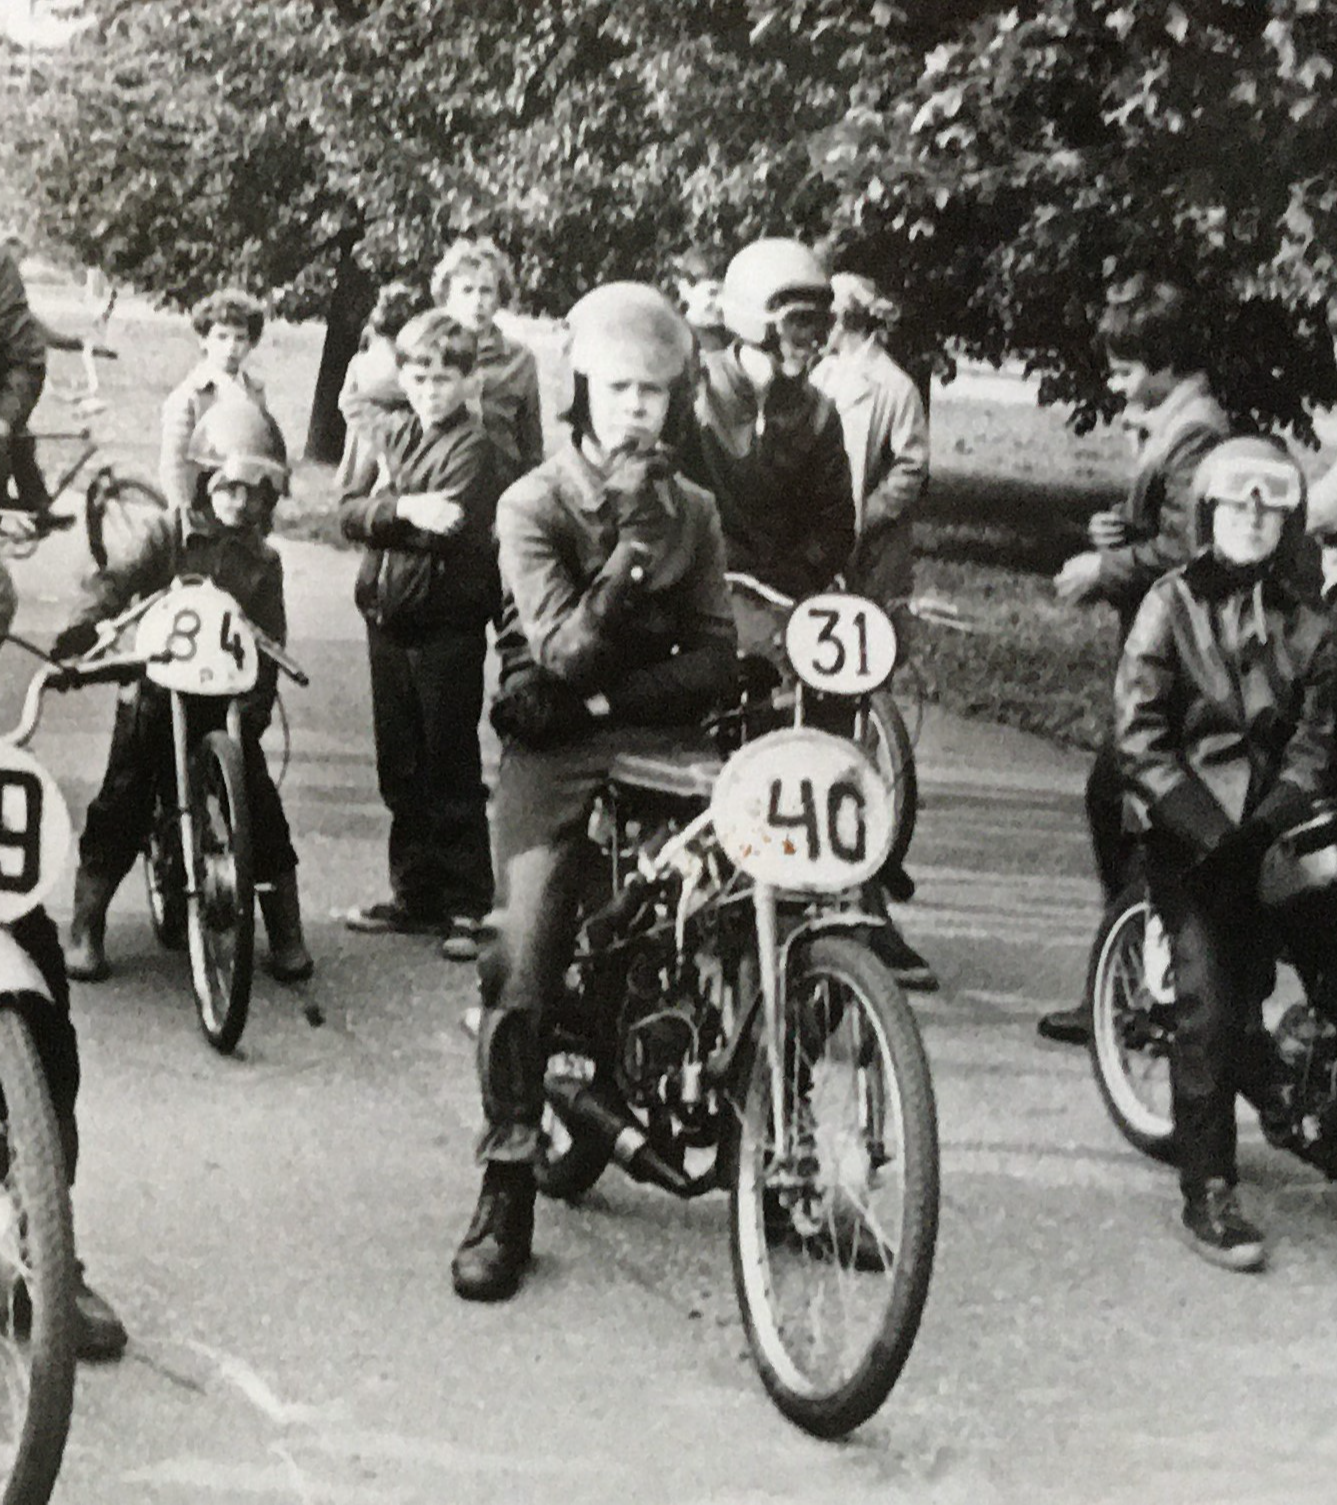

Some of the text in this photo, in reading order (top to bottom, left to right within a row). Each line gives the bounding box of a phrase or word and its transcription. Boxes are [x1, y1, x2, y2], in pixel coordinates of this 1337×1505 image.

[166, 609, 245, 671] 84
[808, 608, 869, 676] 31
[766, 778, 867, 864] 40
